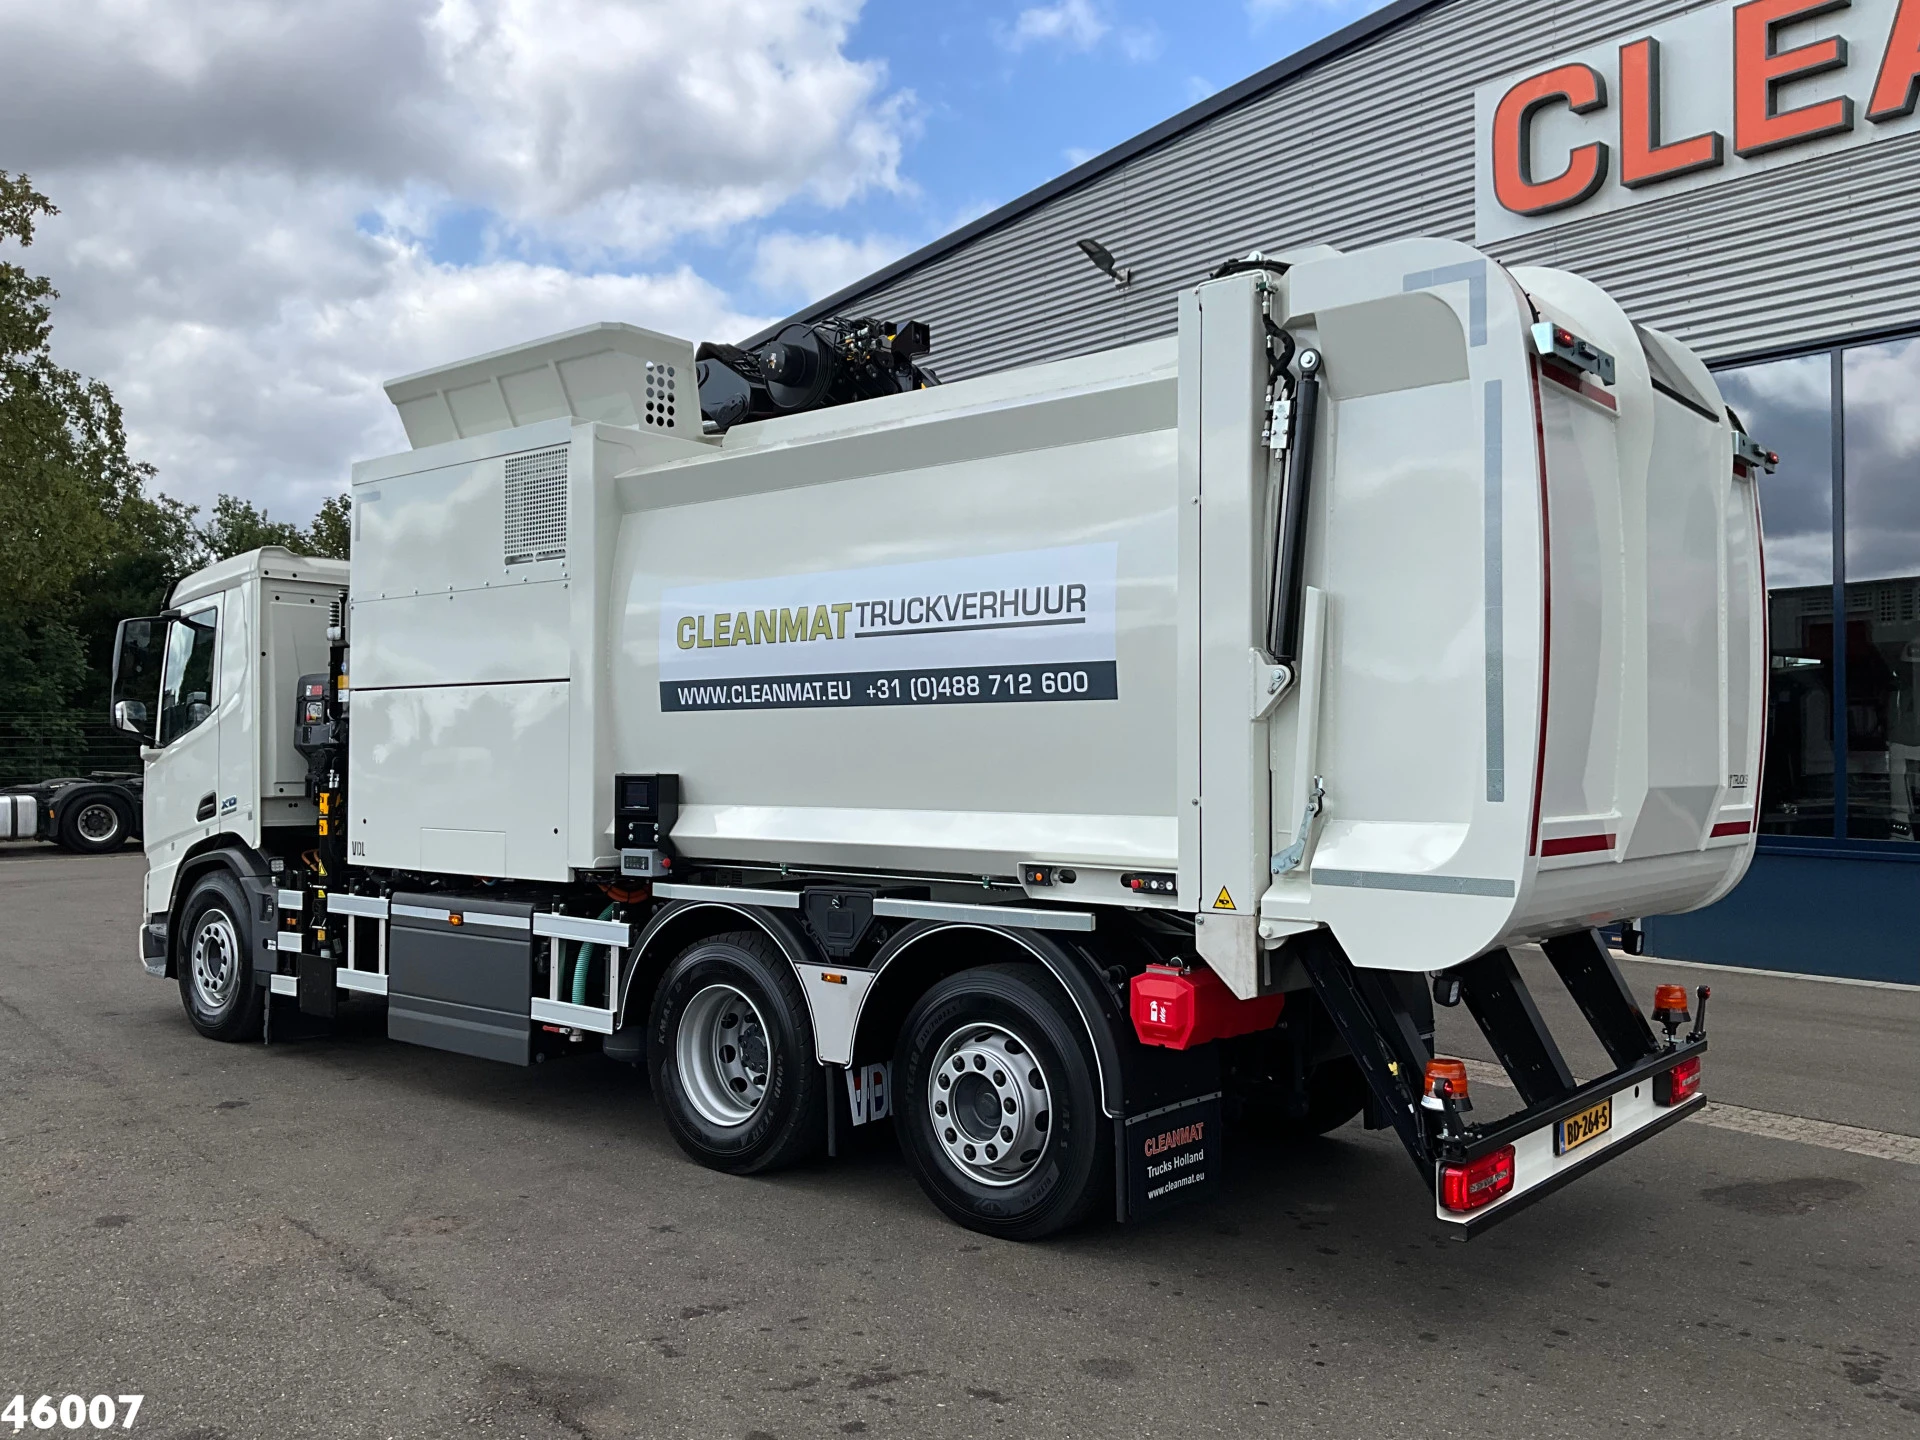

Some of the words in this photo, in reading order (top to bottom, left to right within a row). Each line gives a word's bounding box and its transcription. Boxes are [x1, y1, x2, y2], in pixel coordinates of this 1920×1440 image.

[676, 602, 852, 650] CLEANMAT
[855, 583, 1086, 627] TRUCKVERHUUR
[678, 681, 851, 705] WWW.CLEANMAT.EU
[866, 679, 901, 700] +31
[911, 676, 980, 701] (0)488
[988, 673, 1033, 695] 712
[1041, 670, 1089, 694] 600
[351, 841, 366, 857] VDL
[1144, 1122, 1204, 1157] CLEANMAT
[1566, 1105, 1608, 1146] BD-264-S
[1147, 1160, 1172, 1179] Trucks
[1173, 1148, 1204, 1169] Holland
[1147, 1172, 1205, 1200] www.cleanmat.eu
